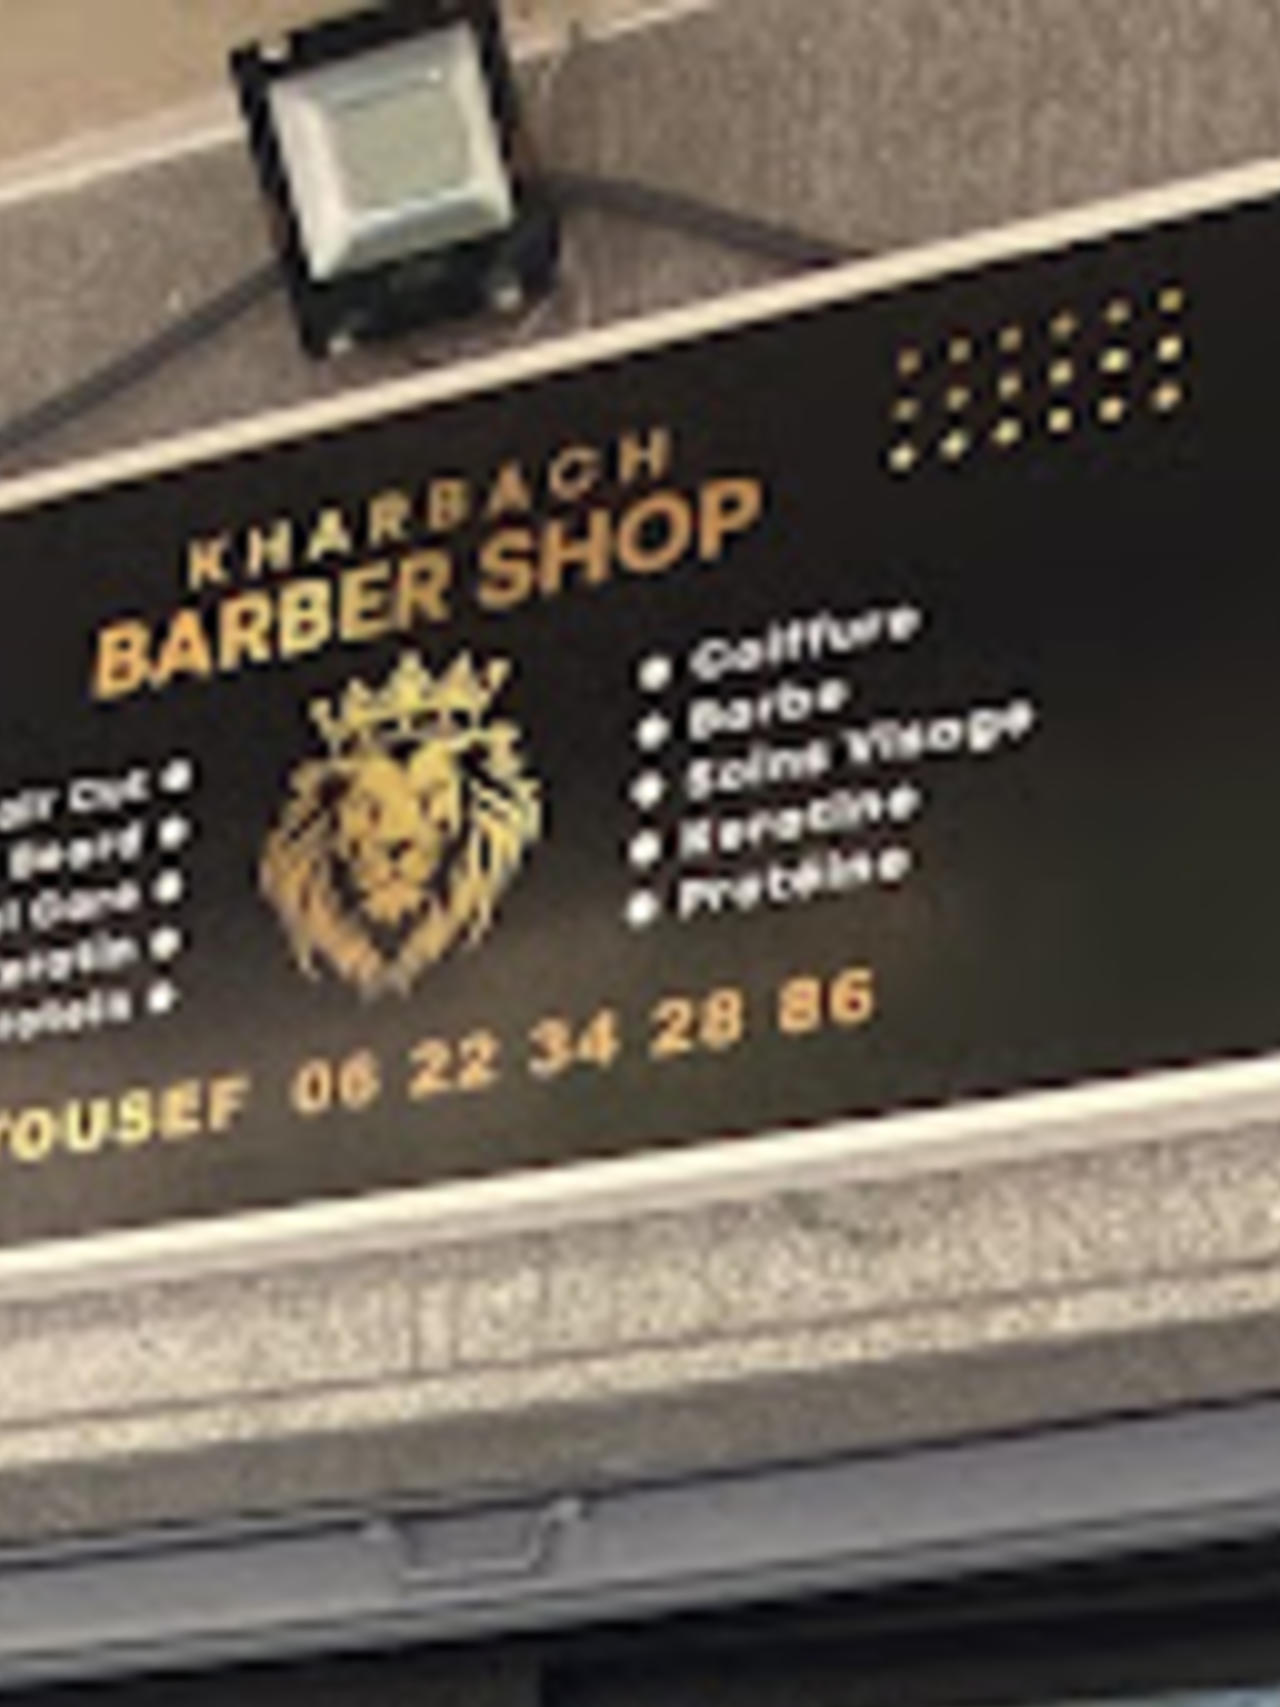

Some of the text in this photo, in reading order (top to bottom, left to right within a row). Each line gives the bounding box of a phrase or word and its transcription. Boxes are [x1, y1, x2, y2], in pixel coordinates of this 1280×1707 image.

[186, 427, 671, 591] KHARBACH
[90, 477, 763, 699] BARBER SHOP
[688, 605, 922, 682] Coiffure
[686, 679, 848, 741] Barbe
[842, 699, 1038, 763] Visage
[291, 1049, 381, 1115] 06
[408, 1028, 502, 1099] 22
[527, 1007, 620, 1080] 34
[649, 986, 744, 1059] 28
[776, 966, 875, 1036] 86
